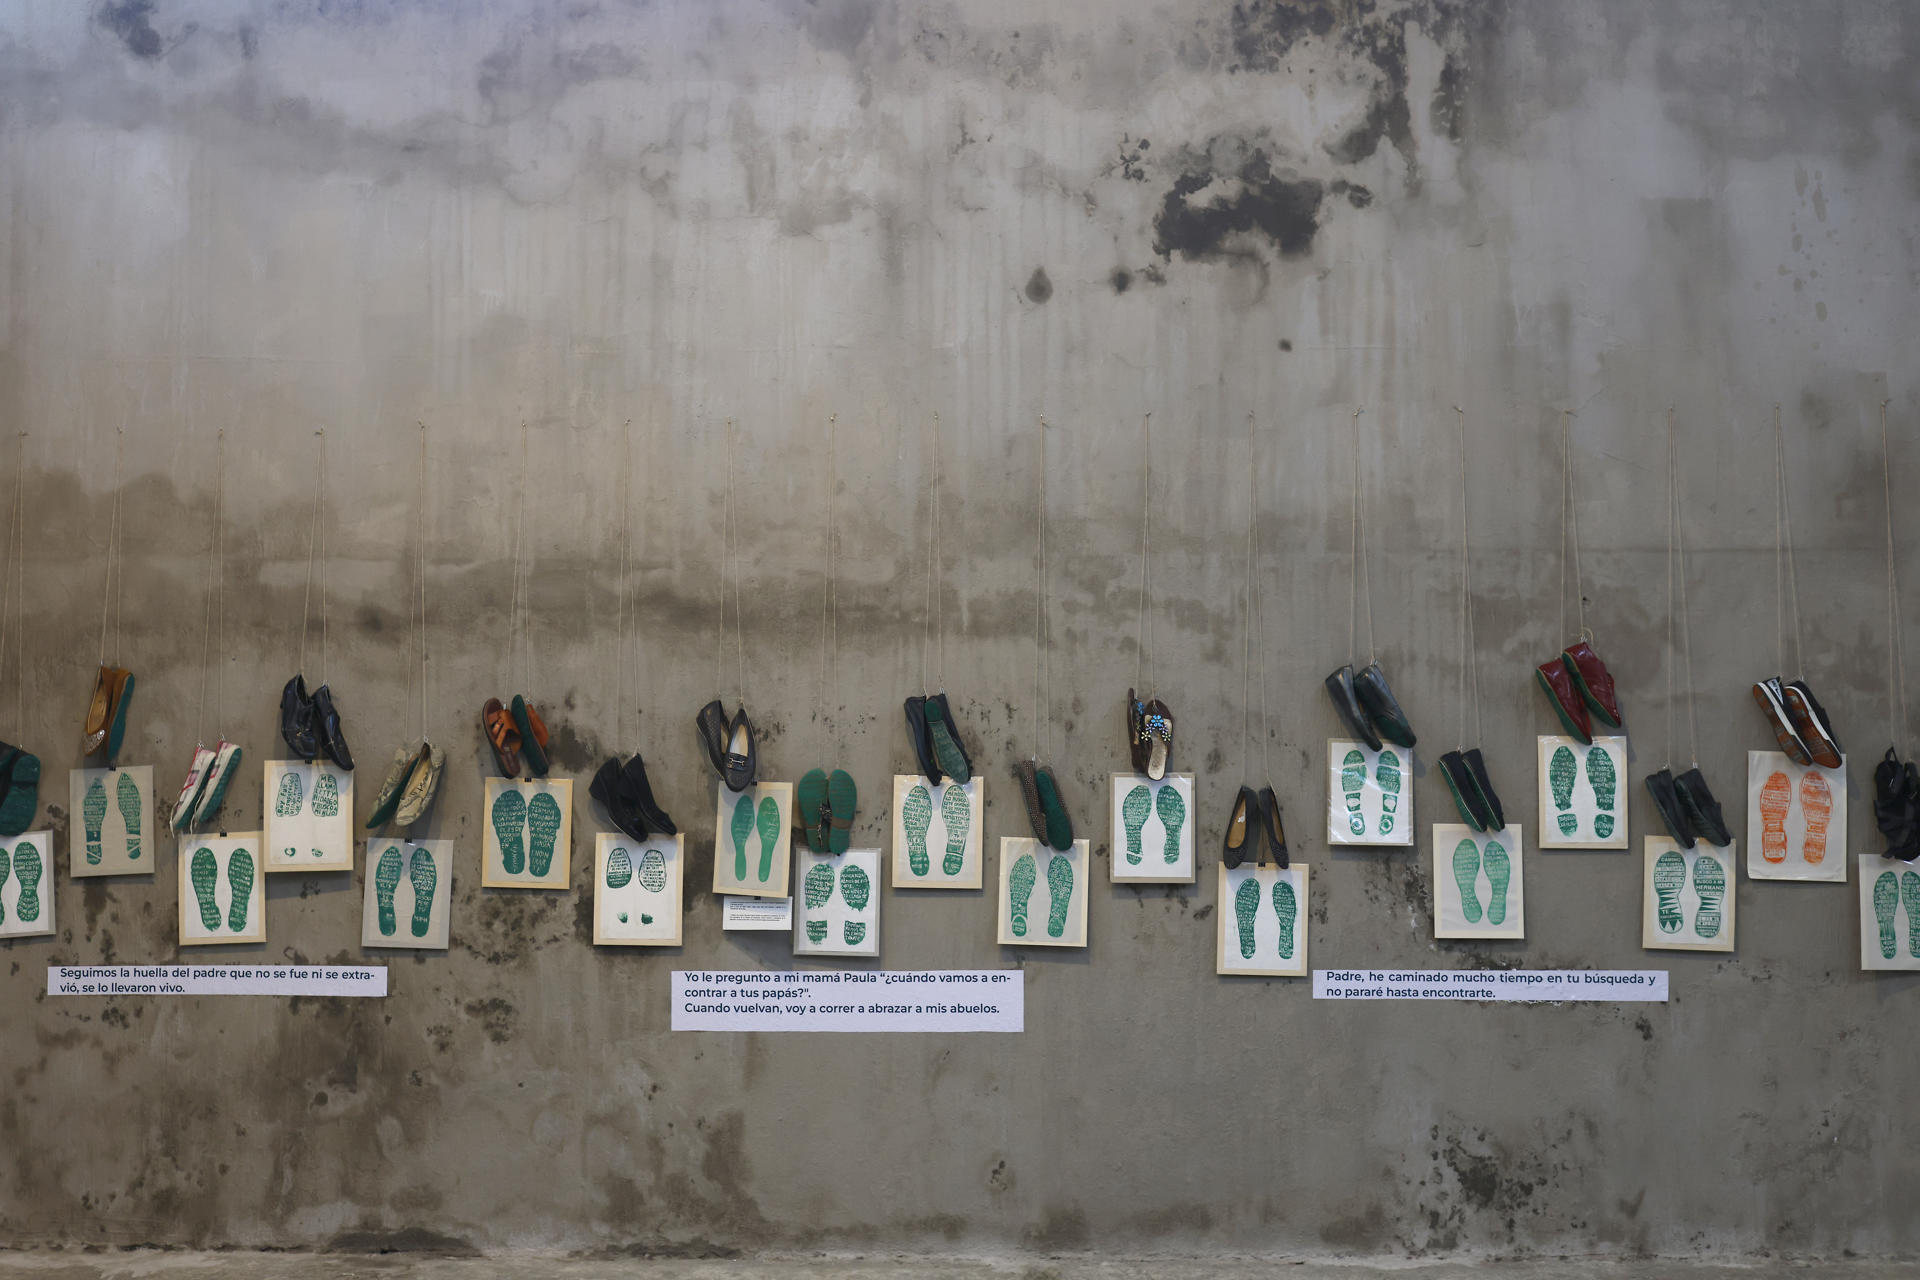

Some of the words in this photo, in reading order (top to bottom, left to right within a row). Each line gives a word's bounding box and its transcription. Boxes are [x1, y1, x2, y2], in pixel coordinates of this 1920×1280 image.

[60, 967, 118, 980] Seguimos
[120, 967, 130, 978] la
[133, 967, 169, 978] huella
[171, 967, 190, 978] del
[193, 967, 227, 980] padre
[229, 970, 253, 981] que
[255, 970, 271, 979] no
[273, 970, 287, 979] se
[289, 968, 309, 979] fue
[311, 968, 323, 979] ni
[325, 971, 339, 980] se
[341, 970, 375, 980] extra-
[684, 972, 699, 982] Yo
[702, 971, 713, 983] le
[715, 973, 771, 985] pregunto
[773, 974, 781, 983] a
[784, 972, 800, 983] mi
[802, 972, 841, 983] mamá
[844, 972, 877, 983] Paula
[879, 972, 936, 985] “¿cuándo
[938, 974, 979, 983] vamos
[981, 974, 988, 983] a
[991, 974, 1011, 983] en-
[1326, 971, 1365, 983] Padre,
[1369, 971, 1385, 982] he
[1388, 971, 1449, 983] caminado
[1452, 972, 1496, 983] mucho
[1499, 972, 1544, 985] tiempo
[1546, 975, 1563, 984] en
[1566, 974, 1580, 984] tu
[1584, 973, 1645, 986] búsqueda
[1648, 976, 1656, 987] y
[59, 982, 80, 995] vió,
[81, 984, 96, 993] se
[97, 982, 109, 993] lo
[111, 982, 157, 993] llevaron
[158, 982, 186, 993] vivo.
[684, 988, 728, 998] contrar
[730, 989, 737, 998] a
[739, 988, 760, 998] tus
[762, 987, 811, 1001] papás?".
[1326, 988, 1342, 997] no
[1345, 986, 1384, 999] pararé
[1386, 986, 1419, 998] hasta
[1422, 988, 1496, 998] encontrarte.
[684, 1002, 731, 1013] Cuando
[733, 1002, 783, 1015] vuelvan,
[785, 1005, 807, 1016] voy
[809, 1005, 816, 1014] a
[819, 1005, 855, 1014] correr
[857, 1005, 865, 1014] a
[868, 1003, 913, 1014] abrazar
[915, 1005, 923, 1014] a
[925, 1002, 948, 1014] mis
[950, 1003, 1000, 1014] abuelos.
